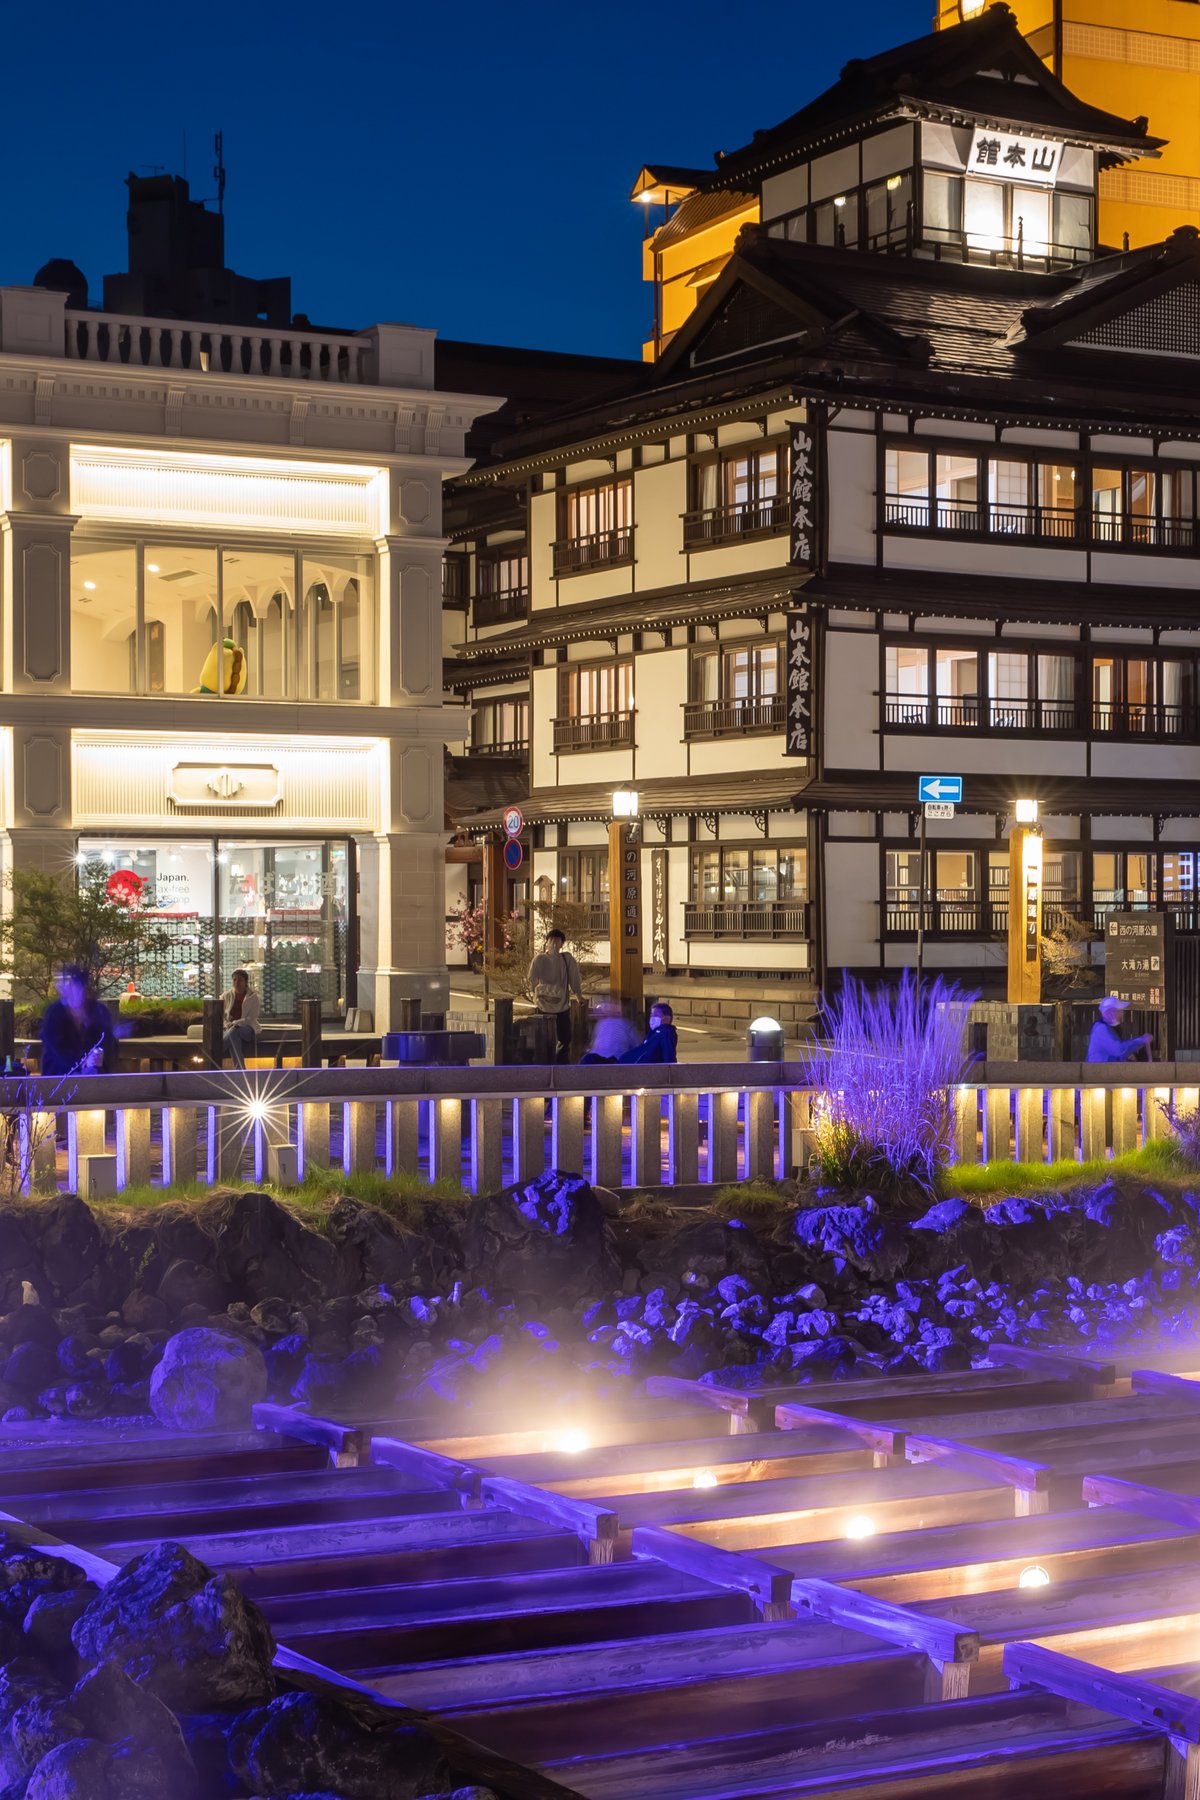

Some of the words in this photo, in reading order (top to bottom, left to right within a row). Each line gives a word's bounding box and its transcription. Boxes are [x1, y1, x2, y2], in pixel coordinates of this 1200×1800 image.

[792, 430, 813, 561] 山本館本店
[789, 620, 811, 751] 山本館本店
[508, 815, 519, 829] 20
[157, 873, 189, 883] Japan.
[1119, 925, 1157, 936] 西の河原公園
[1121, 959, 1150, 971] 大滝乃湯
